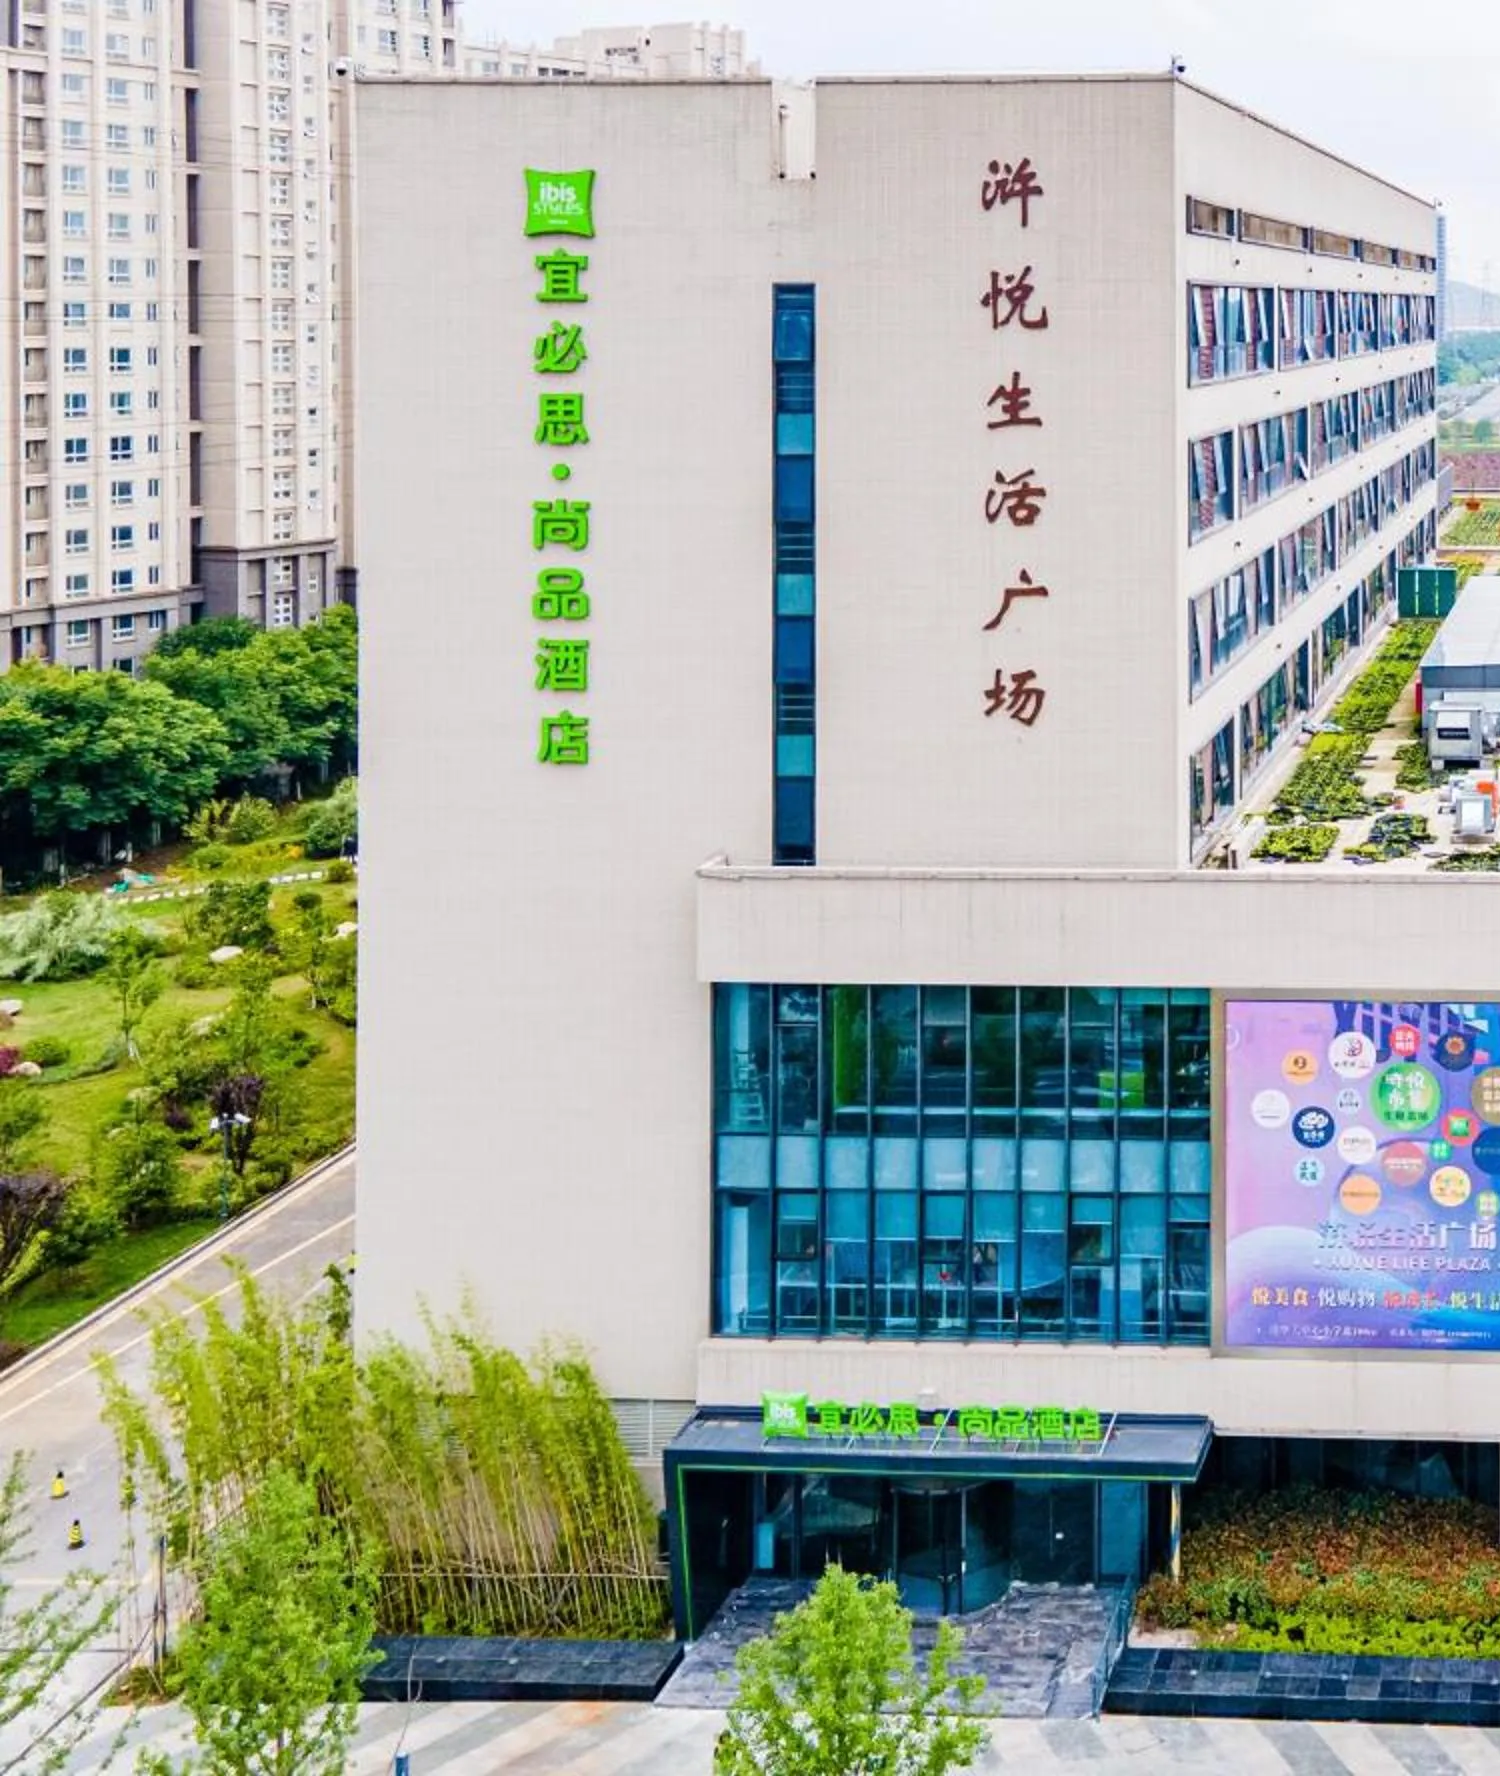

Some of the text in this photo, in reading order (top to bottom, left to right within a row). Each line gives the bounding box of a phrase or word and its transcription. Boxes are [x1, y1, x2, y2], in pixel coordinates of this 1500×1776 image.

[539, 181, 576, 201] ibis
[532, 202, 584, 215] STYLES
[981, 157, 1049, 727] 浒悦生活广场
[1392, 1256, 1431, 1272] LIFE
[1434, 1256, 1491, 1273] PLAZA
